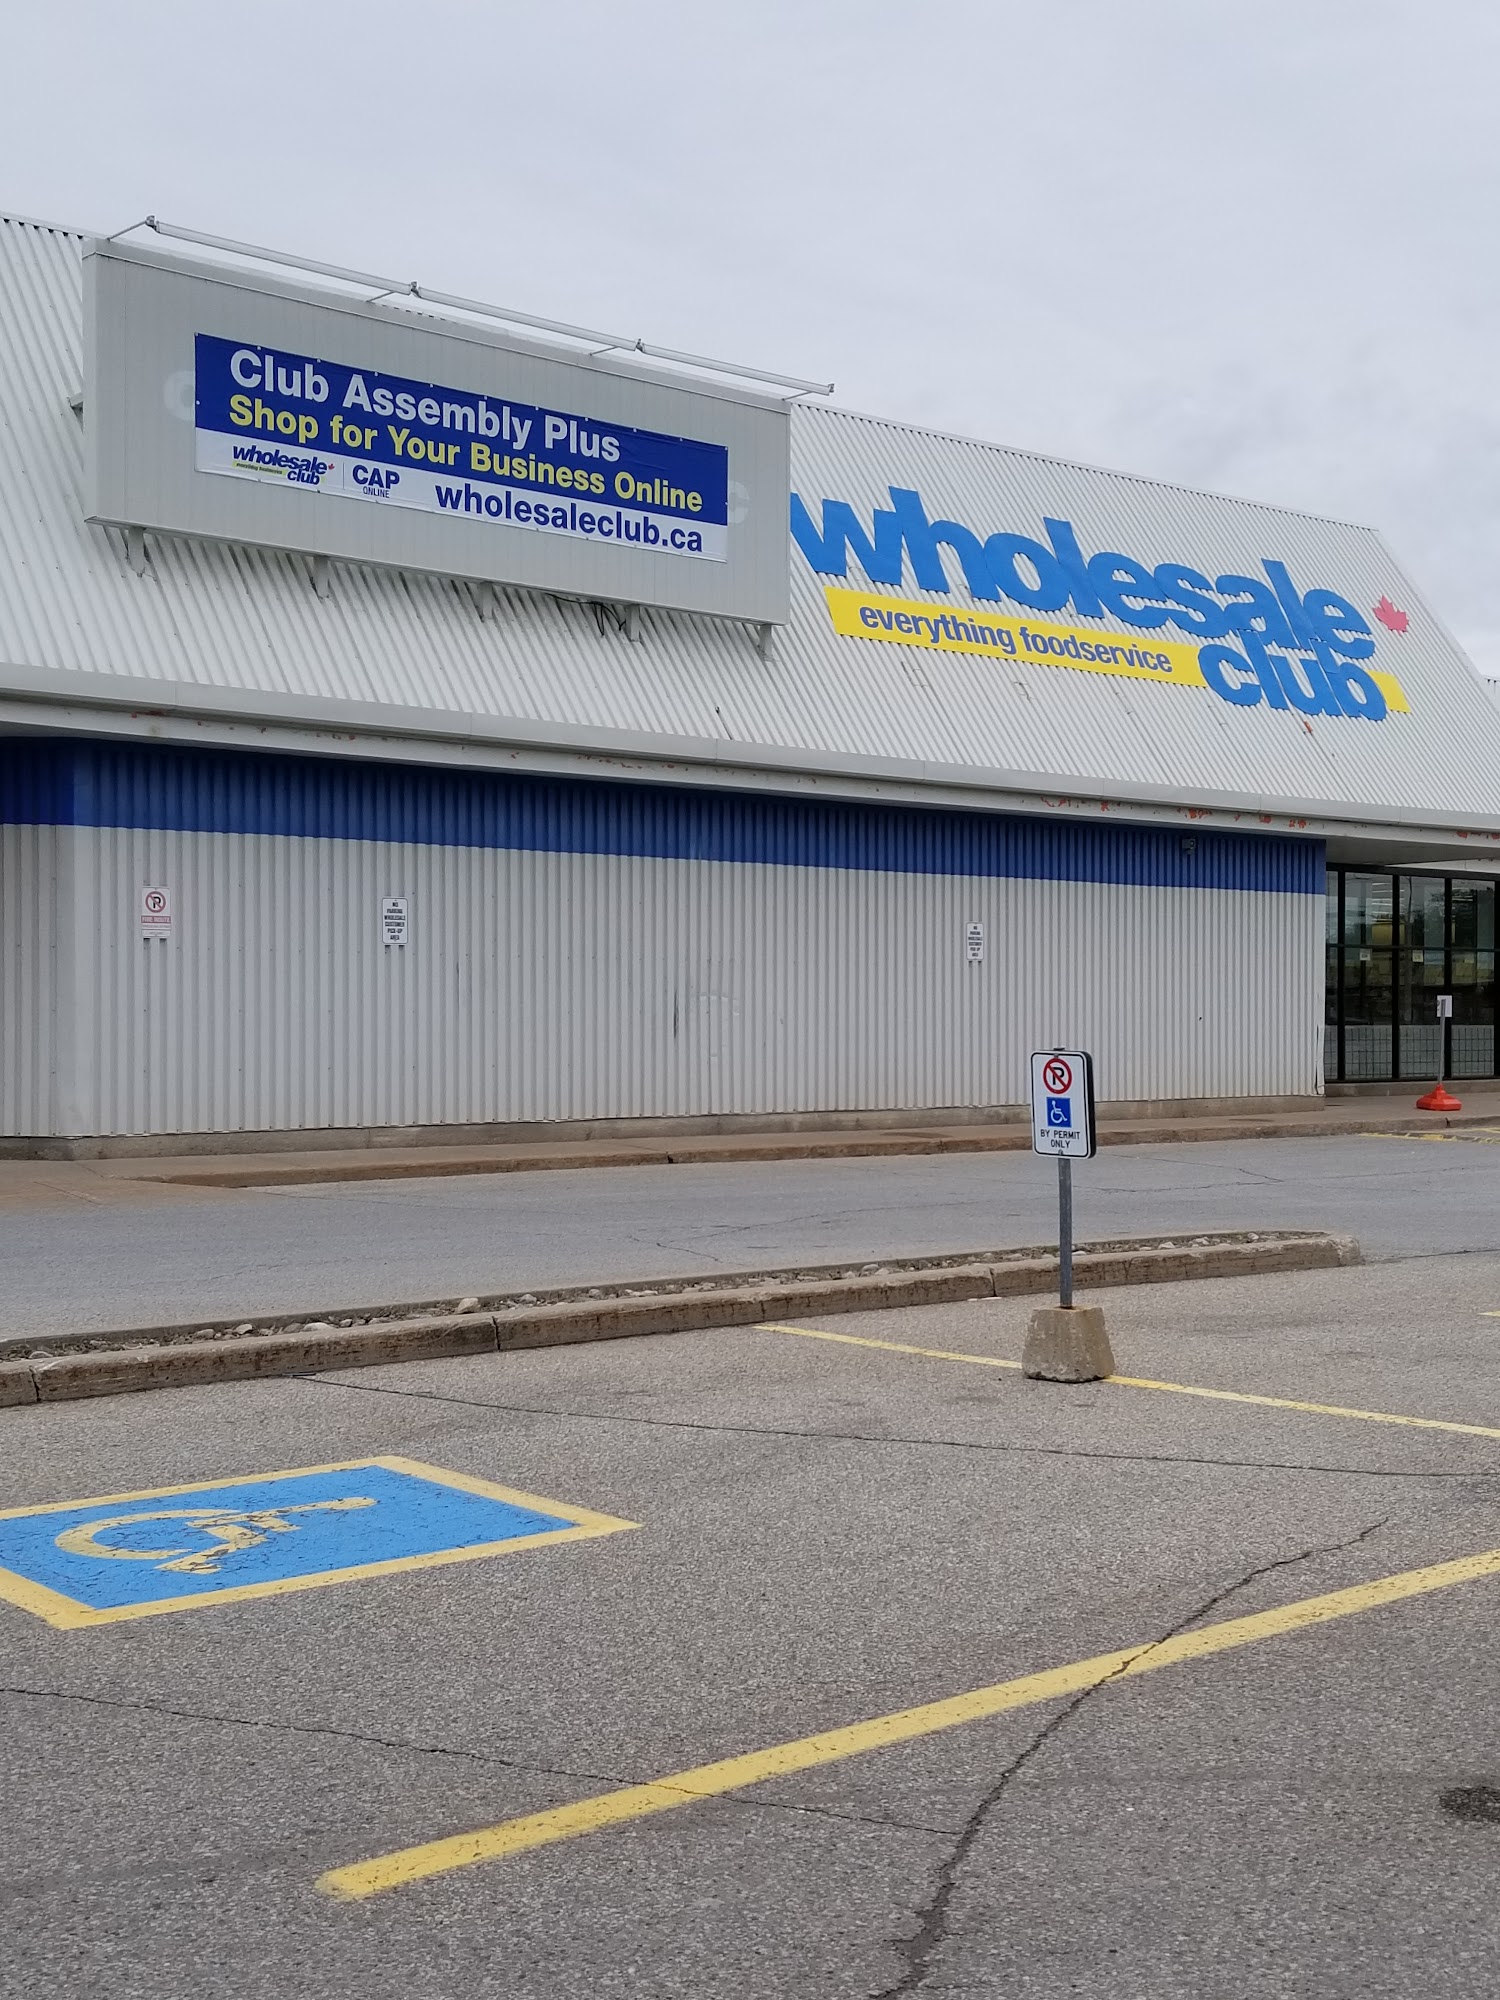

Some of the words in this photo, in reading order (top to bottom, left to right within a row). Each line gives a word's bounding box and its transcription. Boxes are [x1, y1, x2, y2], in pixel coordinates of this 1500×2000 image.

[230, 349, 329, 402] Club
[342, 374, 532, 450] Assembly
[545, 415, 620, 462] Plus
[229, 394, 319, 444] Shop
[330, 415, 378, 450] for
[387, 425, 461, 466] Your
[471, 442, 605, 494] Business
[614, 472, 703, 512] Online
[233, 445, 328, 475] wholesale
[287, 469, 320, 485] club
[352, 464, 400, 489] CAP
[363, 486, 390, 498] ONLINE
[435, 483, 703, 552] wholesaleclub.ca
[790, 485, 1376, 660] wholesale
[859, 605, 1017, 655] everything
[1019, 626, 1173, 673] foodservice
[1197, 629, 1387, 722] club
[1040, 1129, 1050, 1138] BY
[1054, 1130, 1080, 1140] PERMIT
[1051, 1139, 1070, 1148] ONLY
